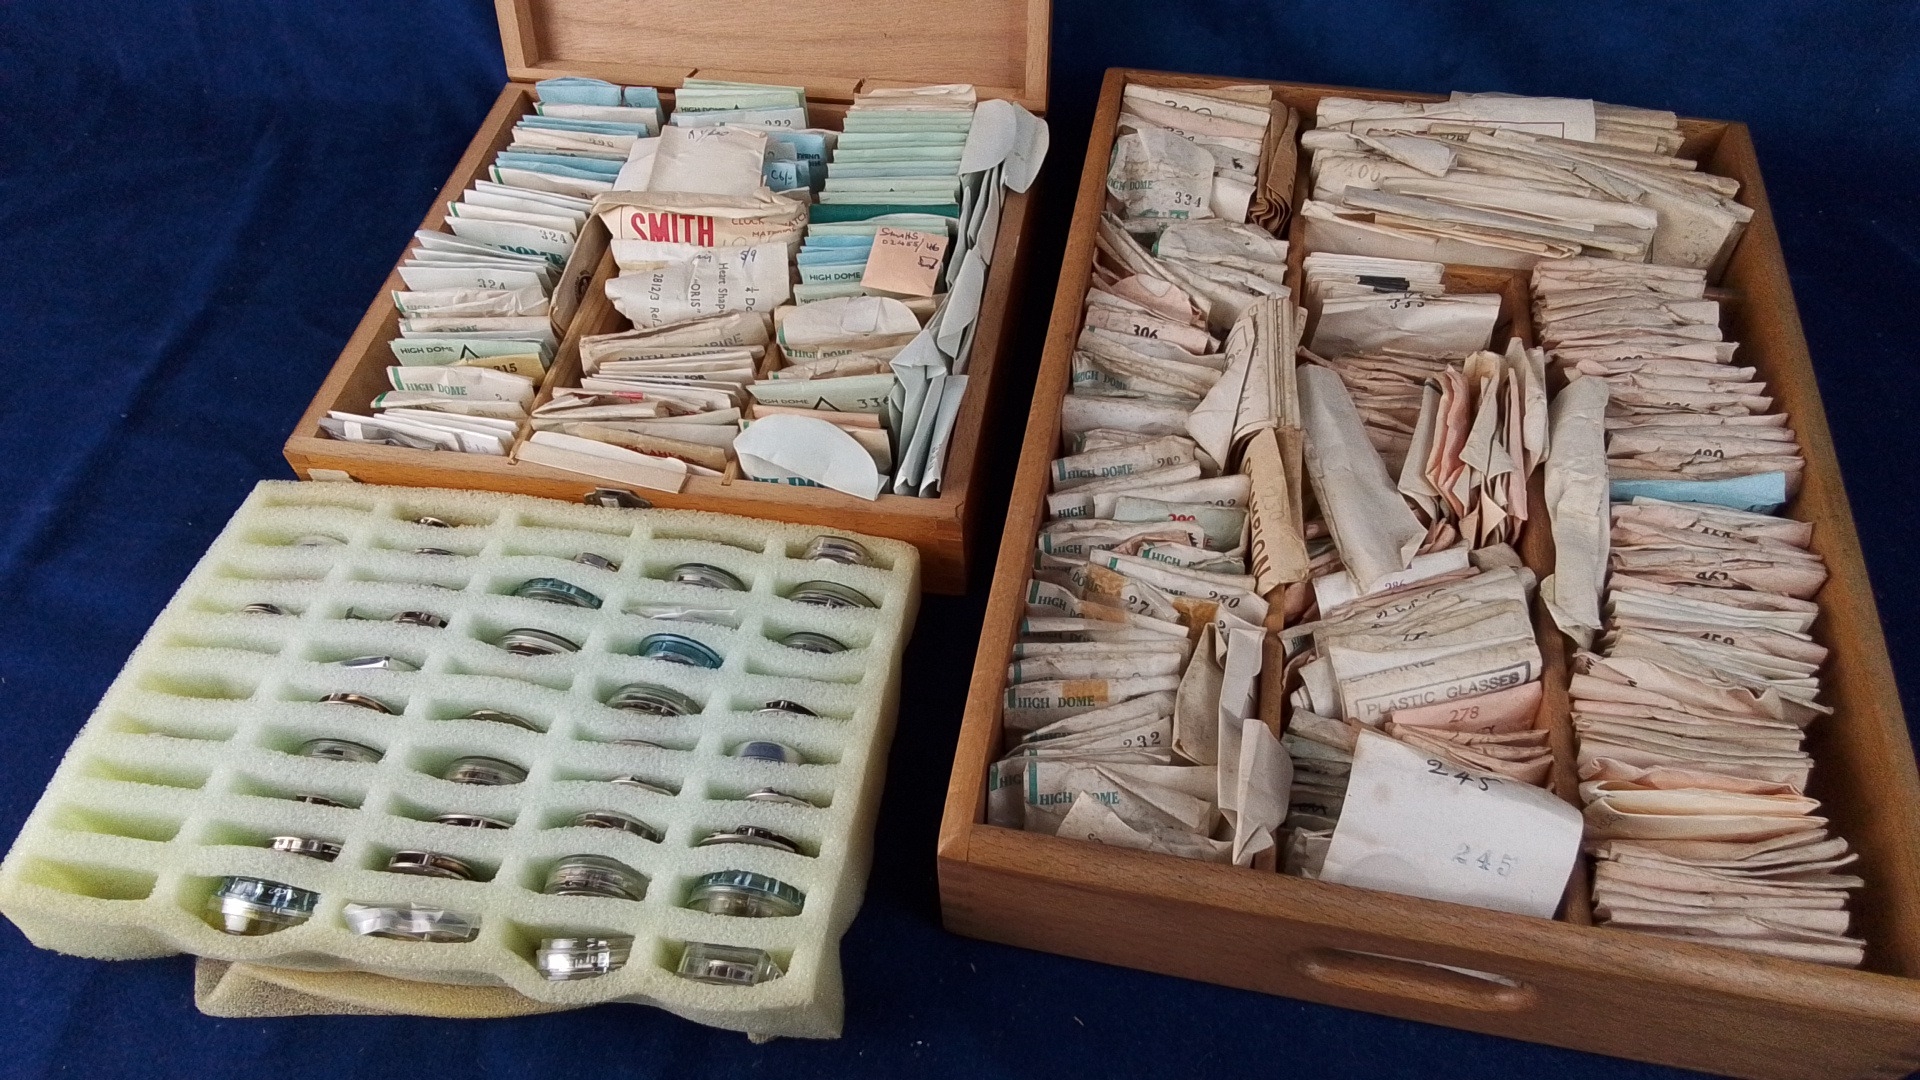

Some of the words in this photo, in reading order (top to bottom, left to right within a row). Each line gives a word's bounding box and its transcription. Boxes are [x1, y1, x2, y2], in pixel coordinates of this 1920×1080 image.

[1129, 180, 1153, 191] DOME
[1175, 191, 1202, 208] 334
[631, 212, 715, 248] SMITH
[834, 272, 861, 280] DOME
[1133, 325, 1158, 339] 306
[405, 383, 434, 392] HIGH
[438, 383, 468, 396] DOME
[1067, 468, 1095, 479] HIGH
[1102, 463, 1134, 478] DOME
[1058, 505, 1087, 518] HIGH
[1152, 552, 1181, 567] HIGH
[1038, 595, 1067, 611] HIGH
[1209, 590, 1241, 609] 280
[1018, 697, 1050, 709] HIGH
[1057, 695, 1096, 708] DOME
[1367, 692, 1435, 716] PLASTIC
[1447, 672, 1520, 699] GLASSES
[1449, 706, 1480, 723] 278
[1123, 731, 1161, 748] 232
[1000, 774, 1024, 788] HIG
[1426, 758, 1503, 791] 245
[1039, 792, 1073, 805] HIGH
[1091, 791, 1120, 805] OME
[1451, 843, 1519, 877] 245
